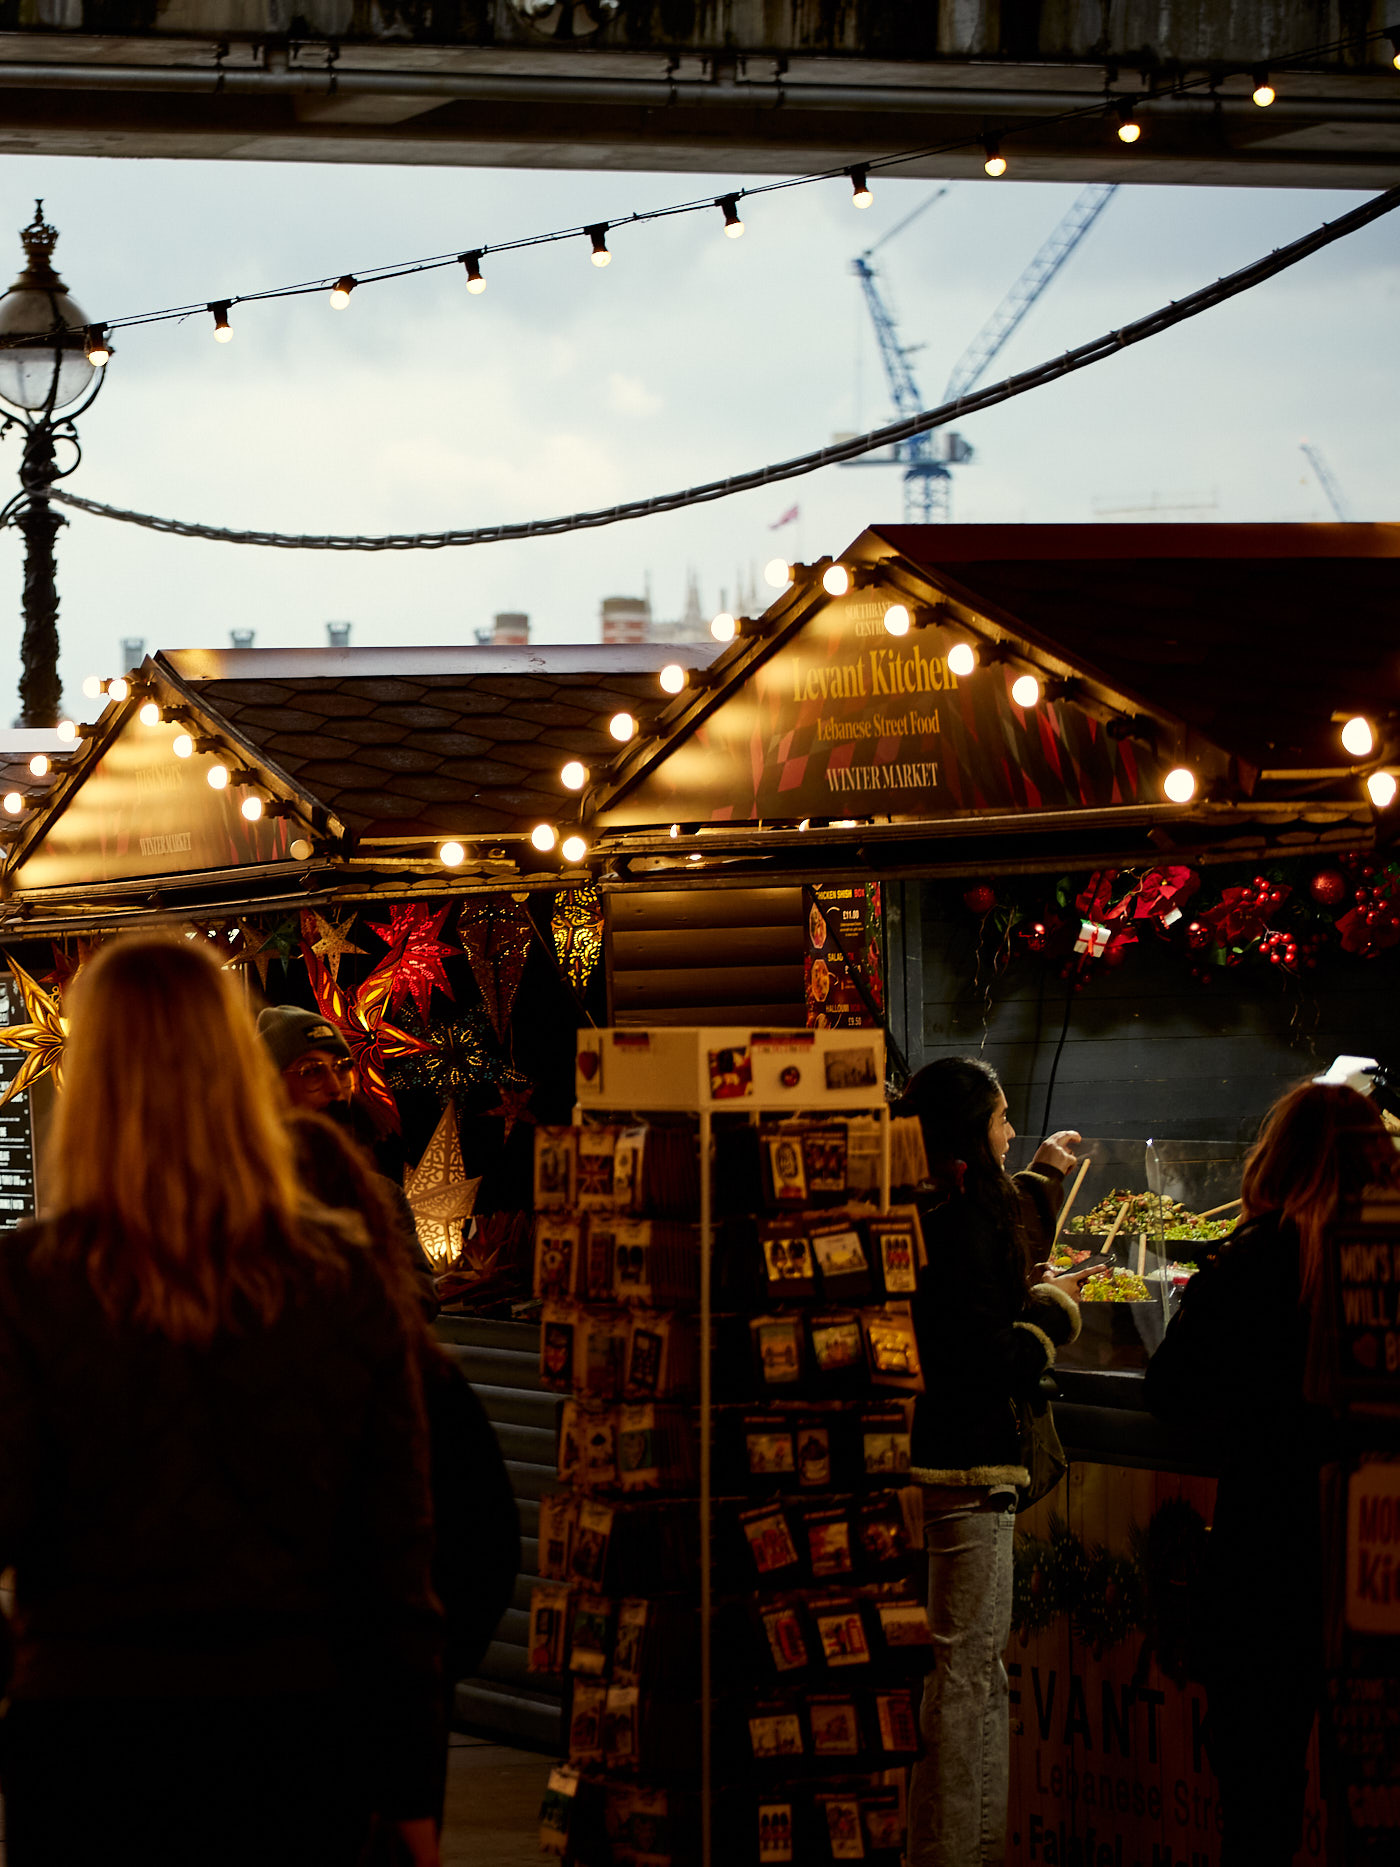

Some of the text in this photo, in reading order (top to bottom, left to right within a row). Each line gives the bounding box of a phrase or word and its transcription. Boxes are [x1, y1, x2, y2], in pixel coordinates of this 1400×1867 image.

[791, 645, 959, 702] Levant Kitchen
[817, 708, 941, 741] Lebanese Street Food
[826, 763, 938, 792] WINTER MARKET
[853, 888, 865, 898] BOX
[1008, 1662, 1164, 1763] VANT
[1036, 1750, 1225, 1836] Lebanese Stre
